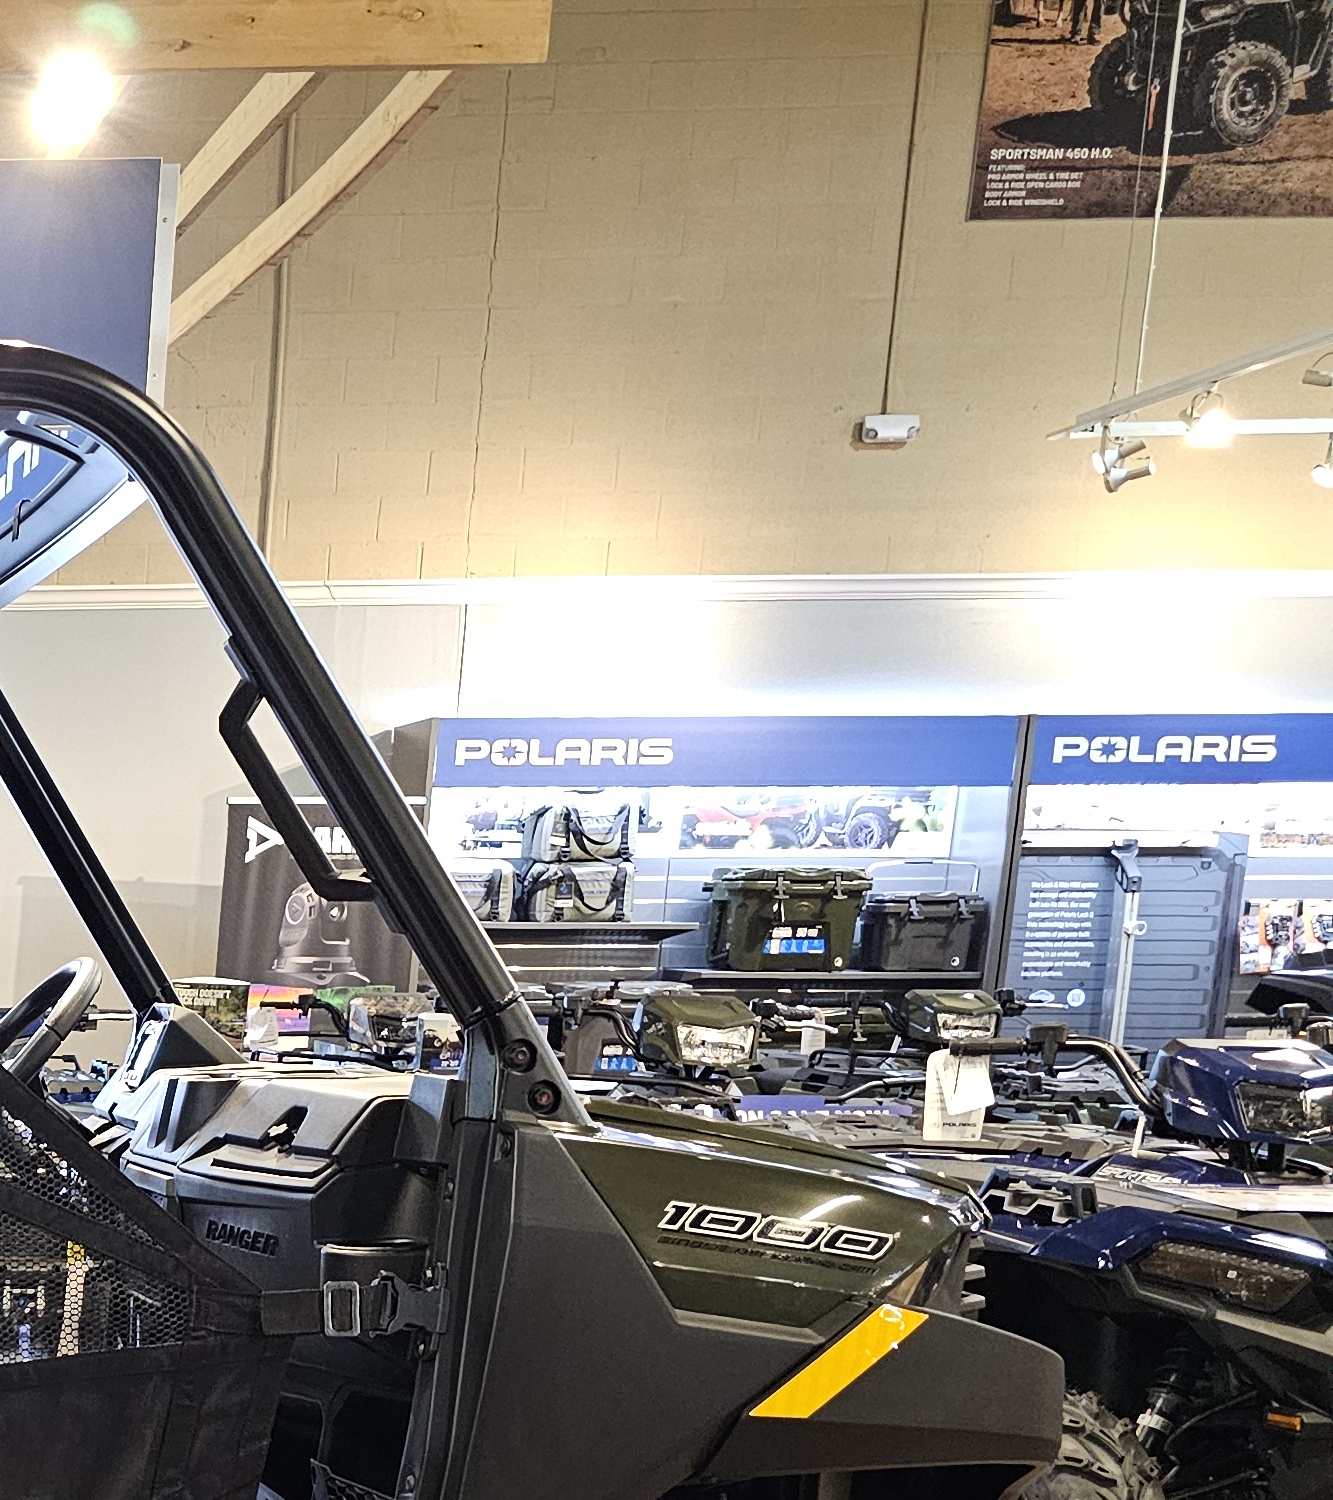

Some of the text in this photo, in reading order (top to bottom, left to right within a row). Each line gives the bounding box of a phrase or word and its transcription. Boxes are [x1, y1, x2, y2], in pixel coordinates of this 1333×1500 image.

[990, 148, 1064, 160] SPORTSMAN
[1090, 147, 1113, 159] H.O.
[454, 737, 674, 766] POLARIS
[1052, 734, 1277, 763] POLARIS
[1098, 1166, 1188, 1185] SPORTSMA
[205, 1219, 280, 1258] RANGER
[657, 1200, 894, 1261] 1000
